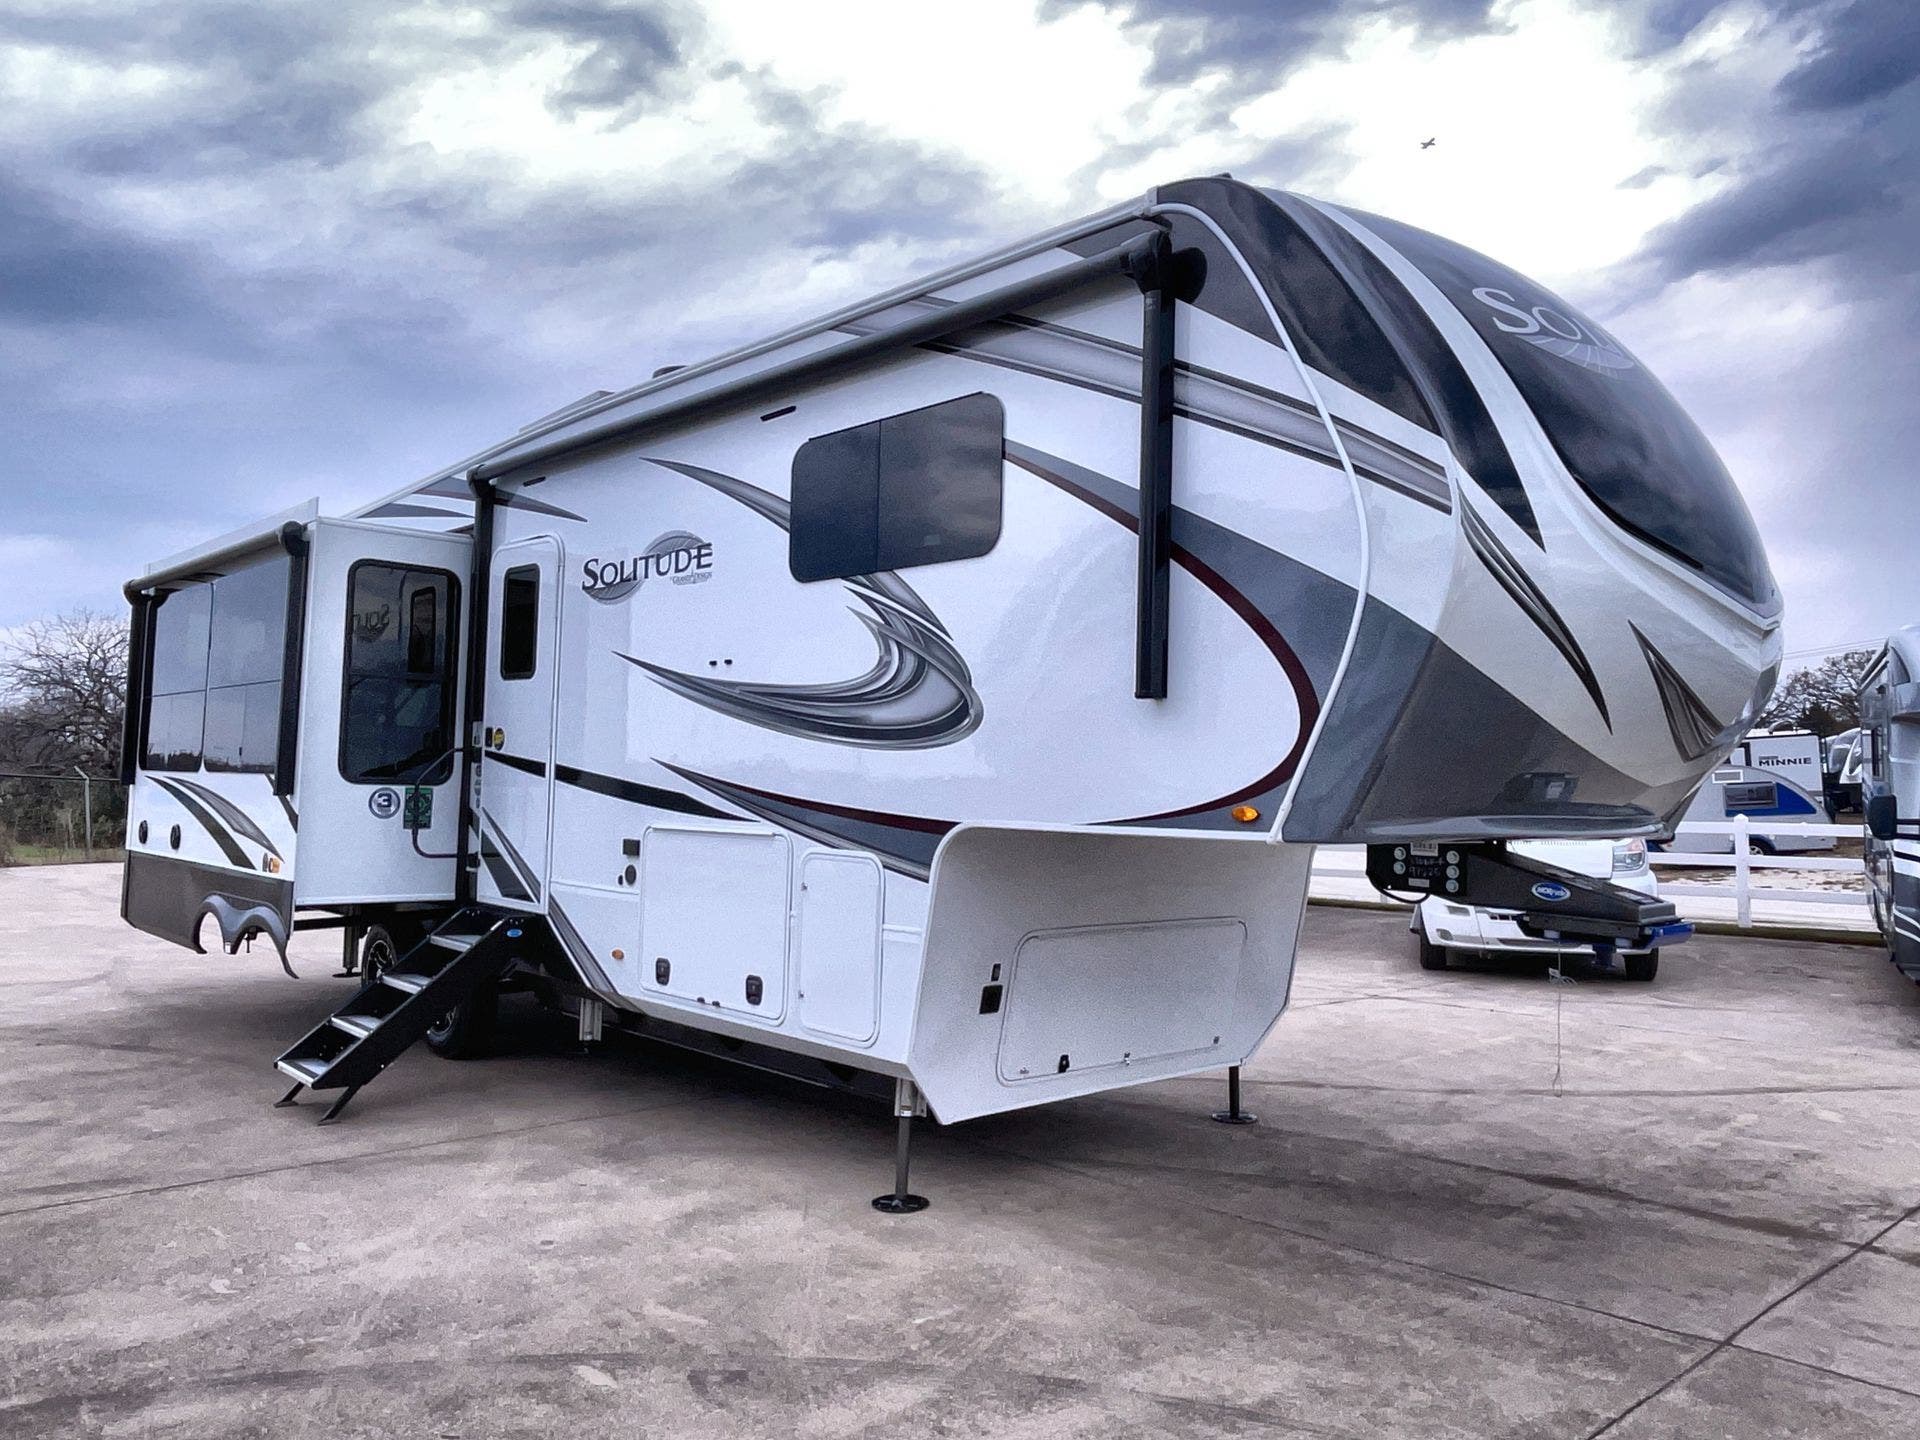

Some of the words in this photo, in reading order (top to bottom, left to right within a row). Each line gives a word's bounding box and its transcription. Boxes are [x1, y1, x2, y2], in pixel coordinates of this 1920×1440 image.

[581, 542, 713, 591] SOLITUDE
[1758, 757, 1812, 767] MINNIE
[377, 792, 392, 808] 3
